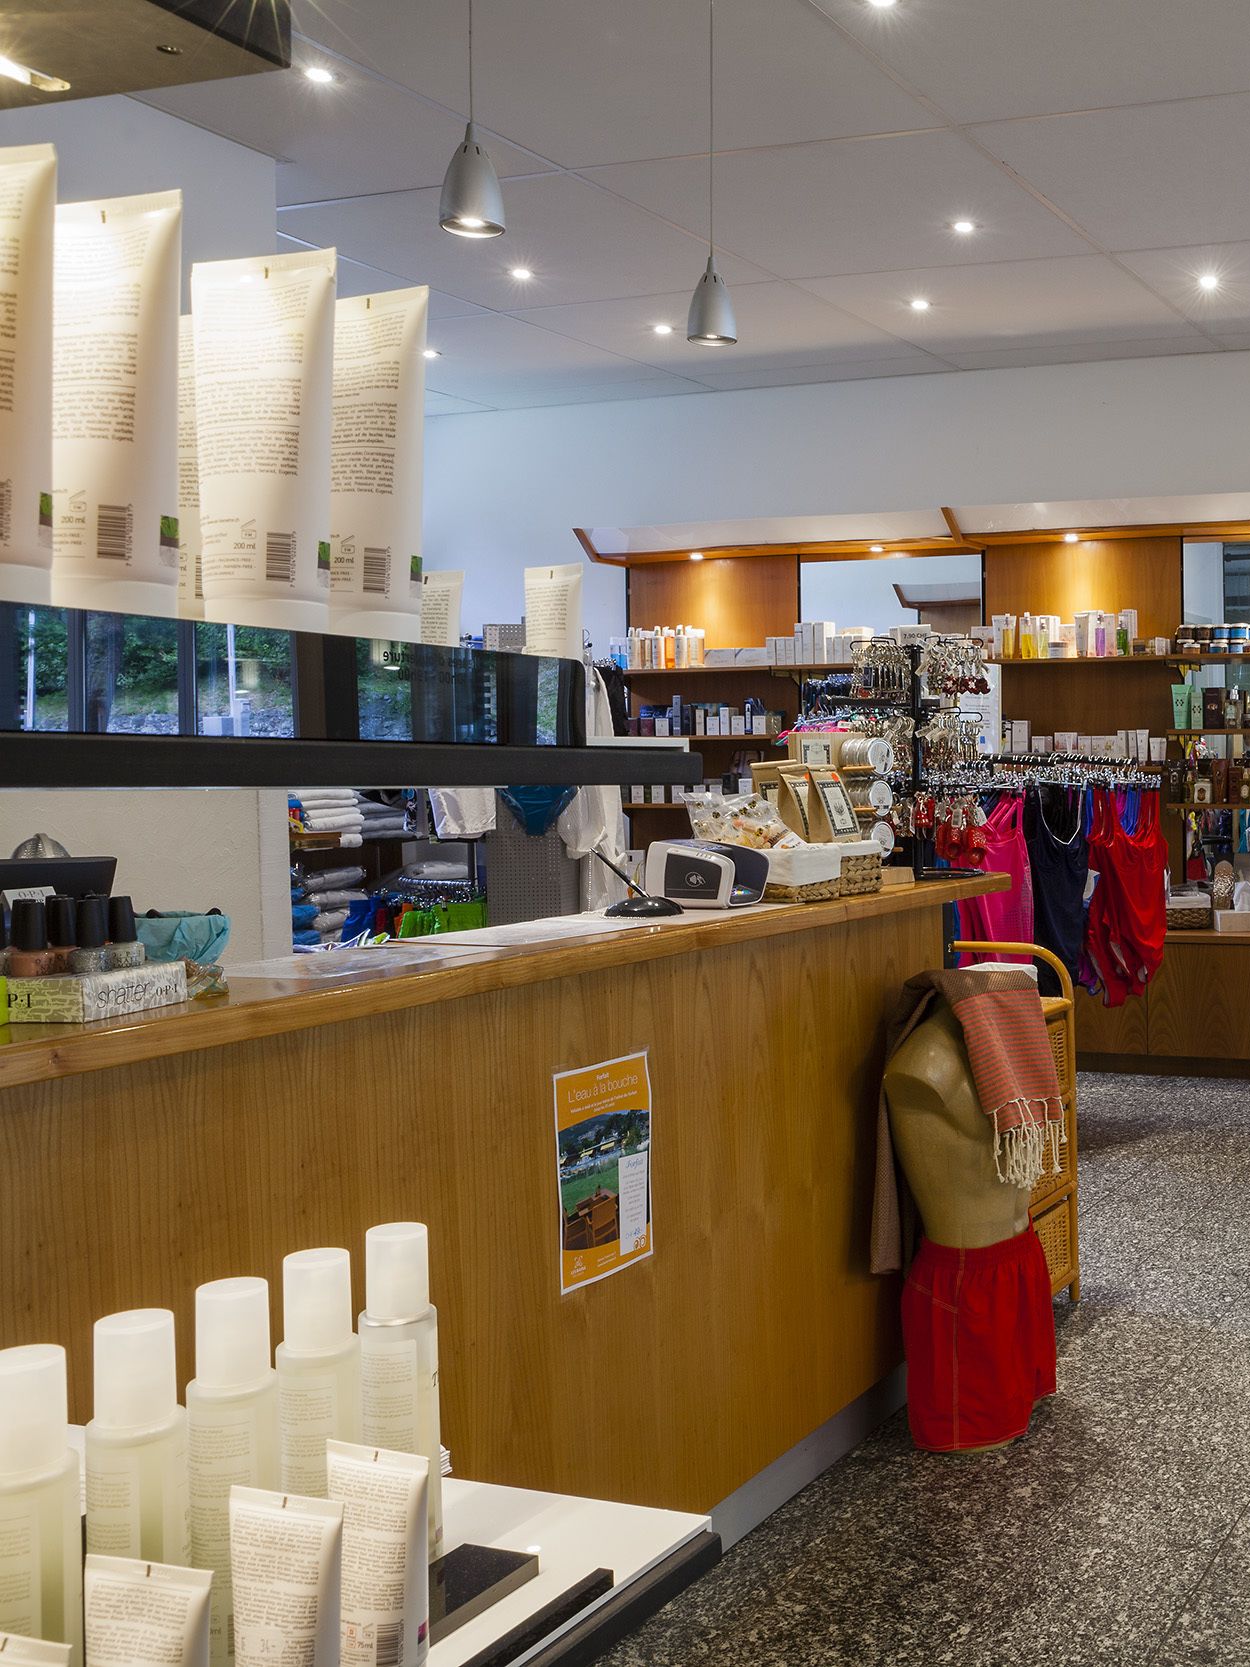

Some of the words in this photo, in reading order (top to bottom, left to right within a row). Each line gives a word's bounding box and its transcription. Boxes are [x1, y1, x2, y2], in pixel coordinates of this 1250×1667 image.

[61, 516, 74, 524] 200
[233, 542, 246, 550] 200
[246, 542, 256, 550] ml
[334, 556, 345, 564] 200
[345, 556, 355, 564] ml
[96, 981, 150, 1008] shatter
[7, 993, 32, 1008] ·P·I
[568, 1087, 592, 1104] L'eau
[600, 1082, 607, 1094] la
[608, 1074, 639, 1092] bouche
